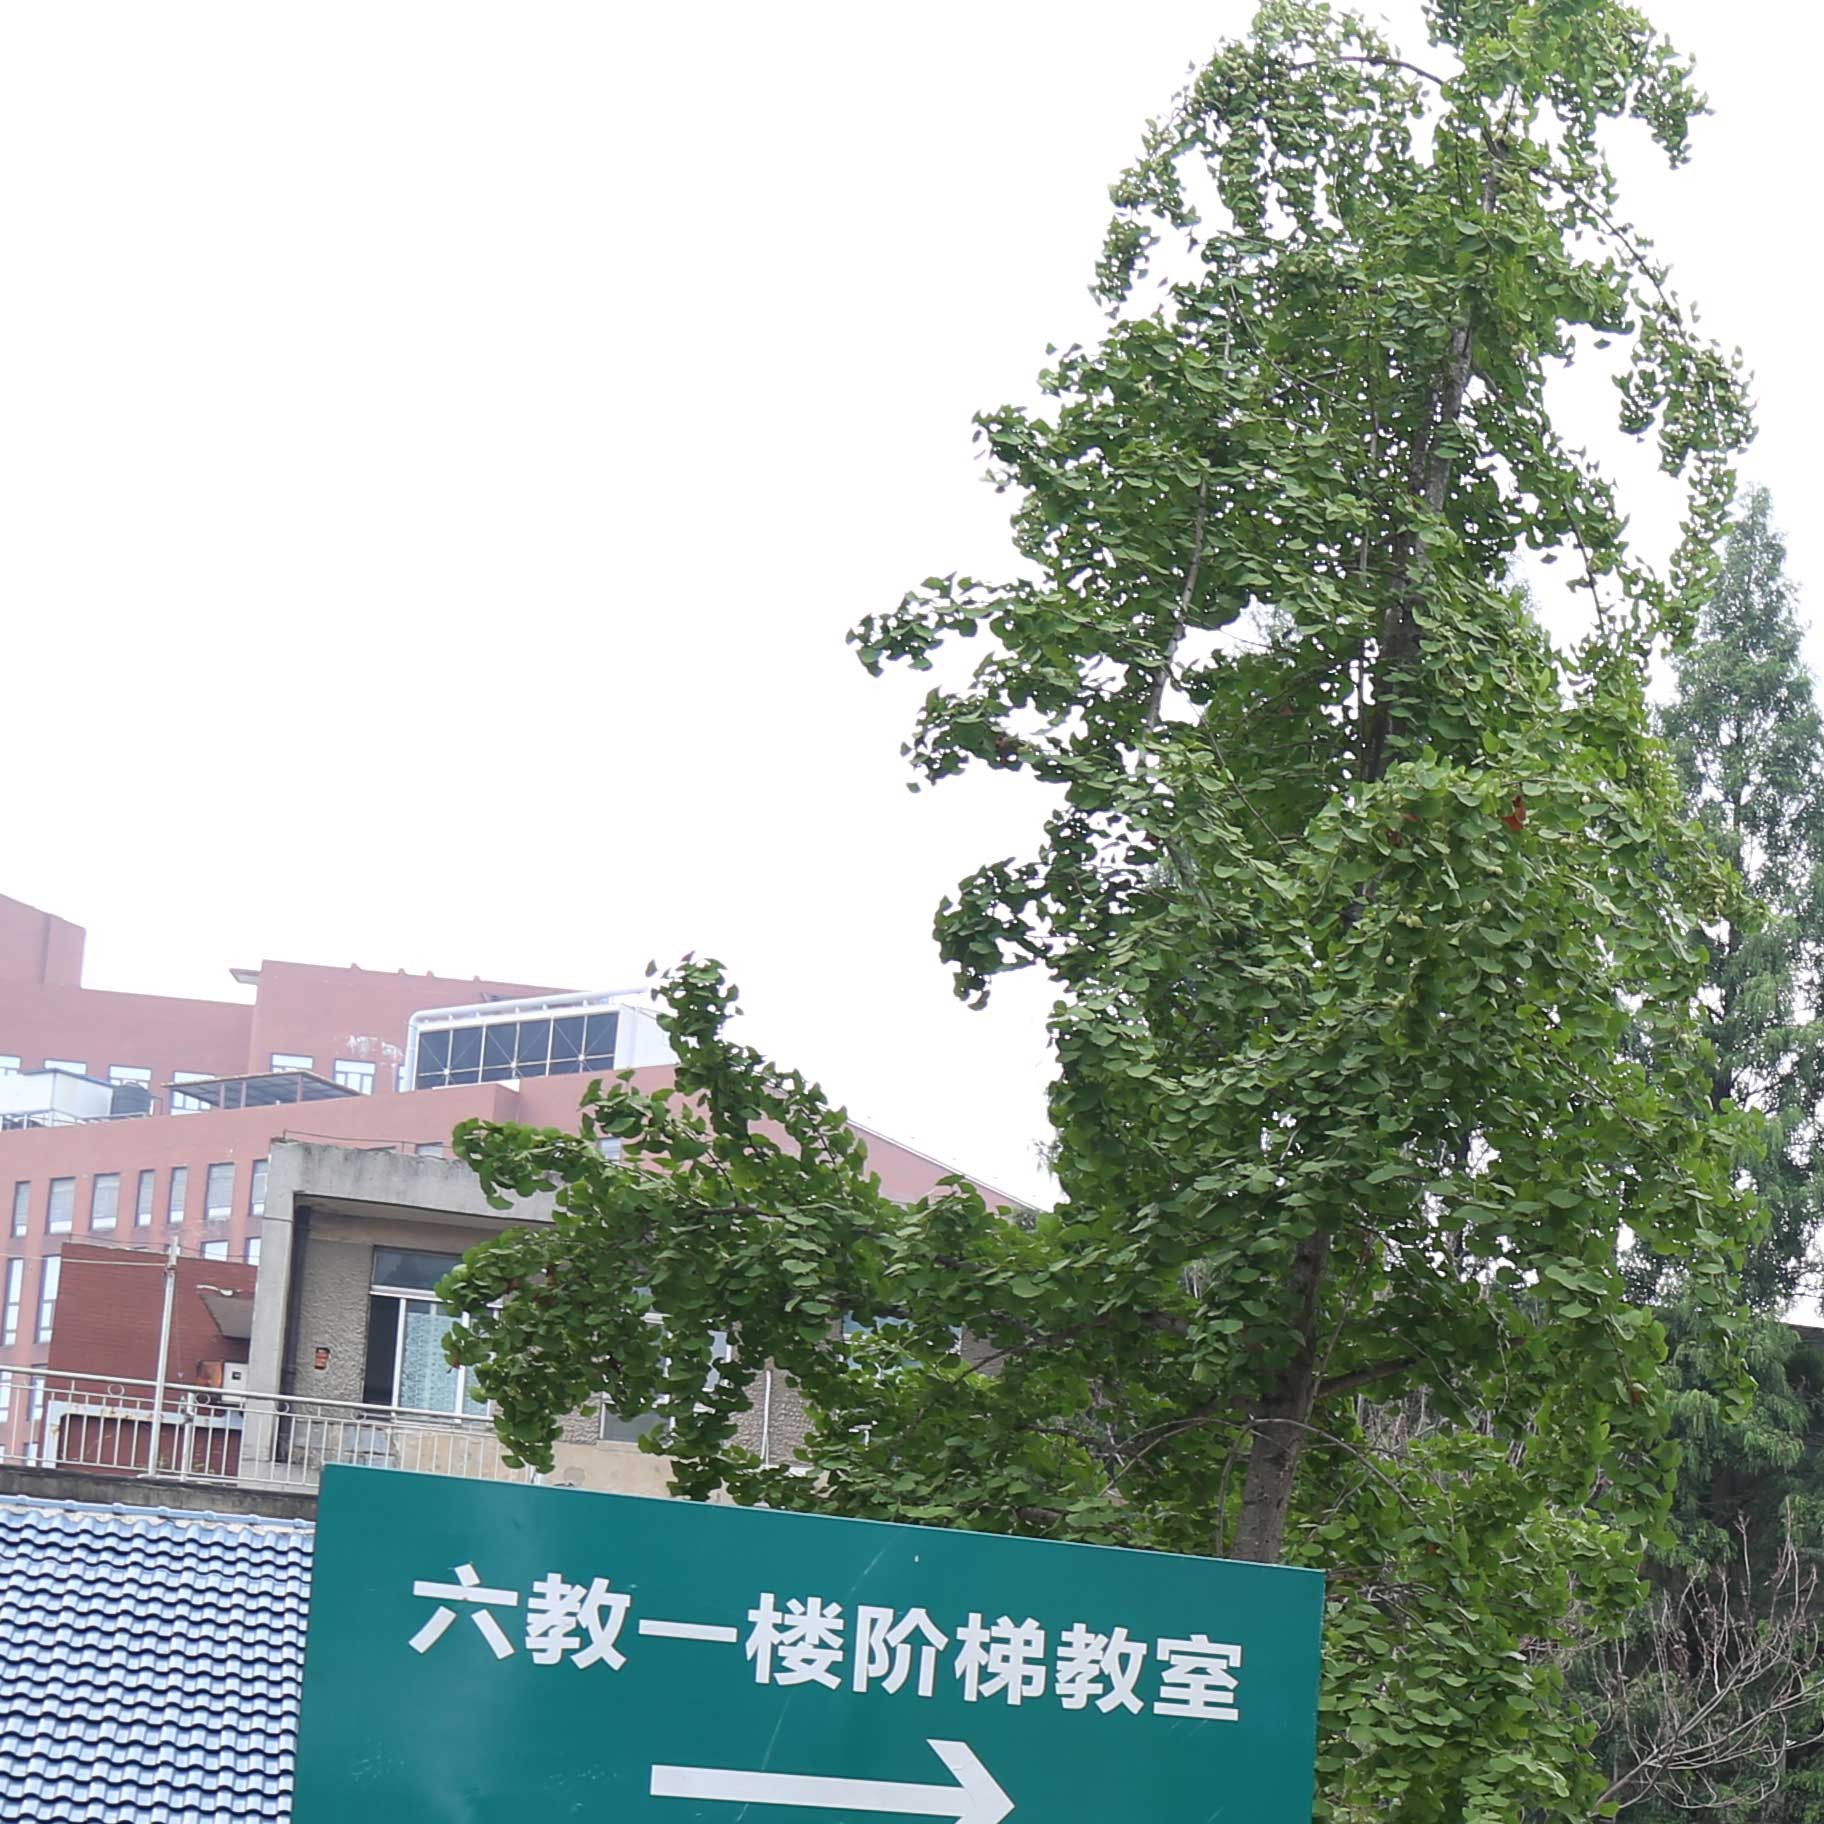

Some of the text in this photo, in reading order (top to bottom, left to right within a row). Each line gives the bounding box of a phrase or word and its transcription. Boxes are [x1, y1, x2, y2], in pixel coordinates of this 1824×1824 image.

[408, 1562, 1242, 1721] 六教一楼阶梯教室
